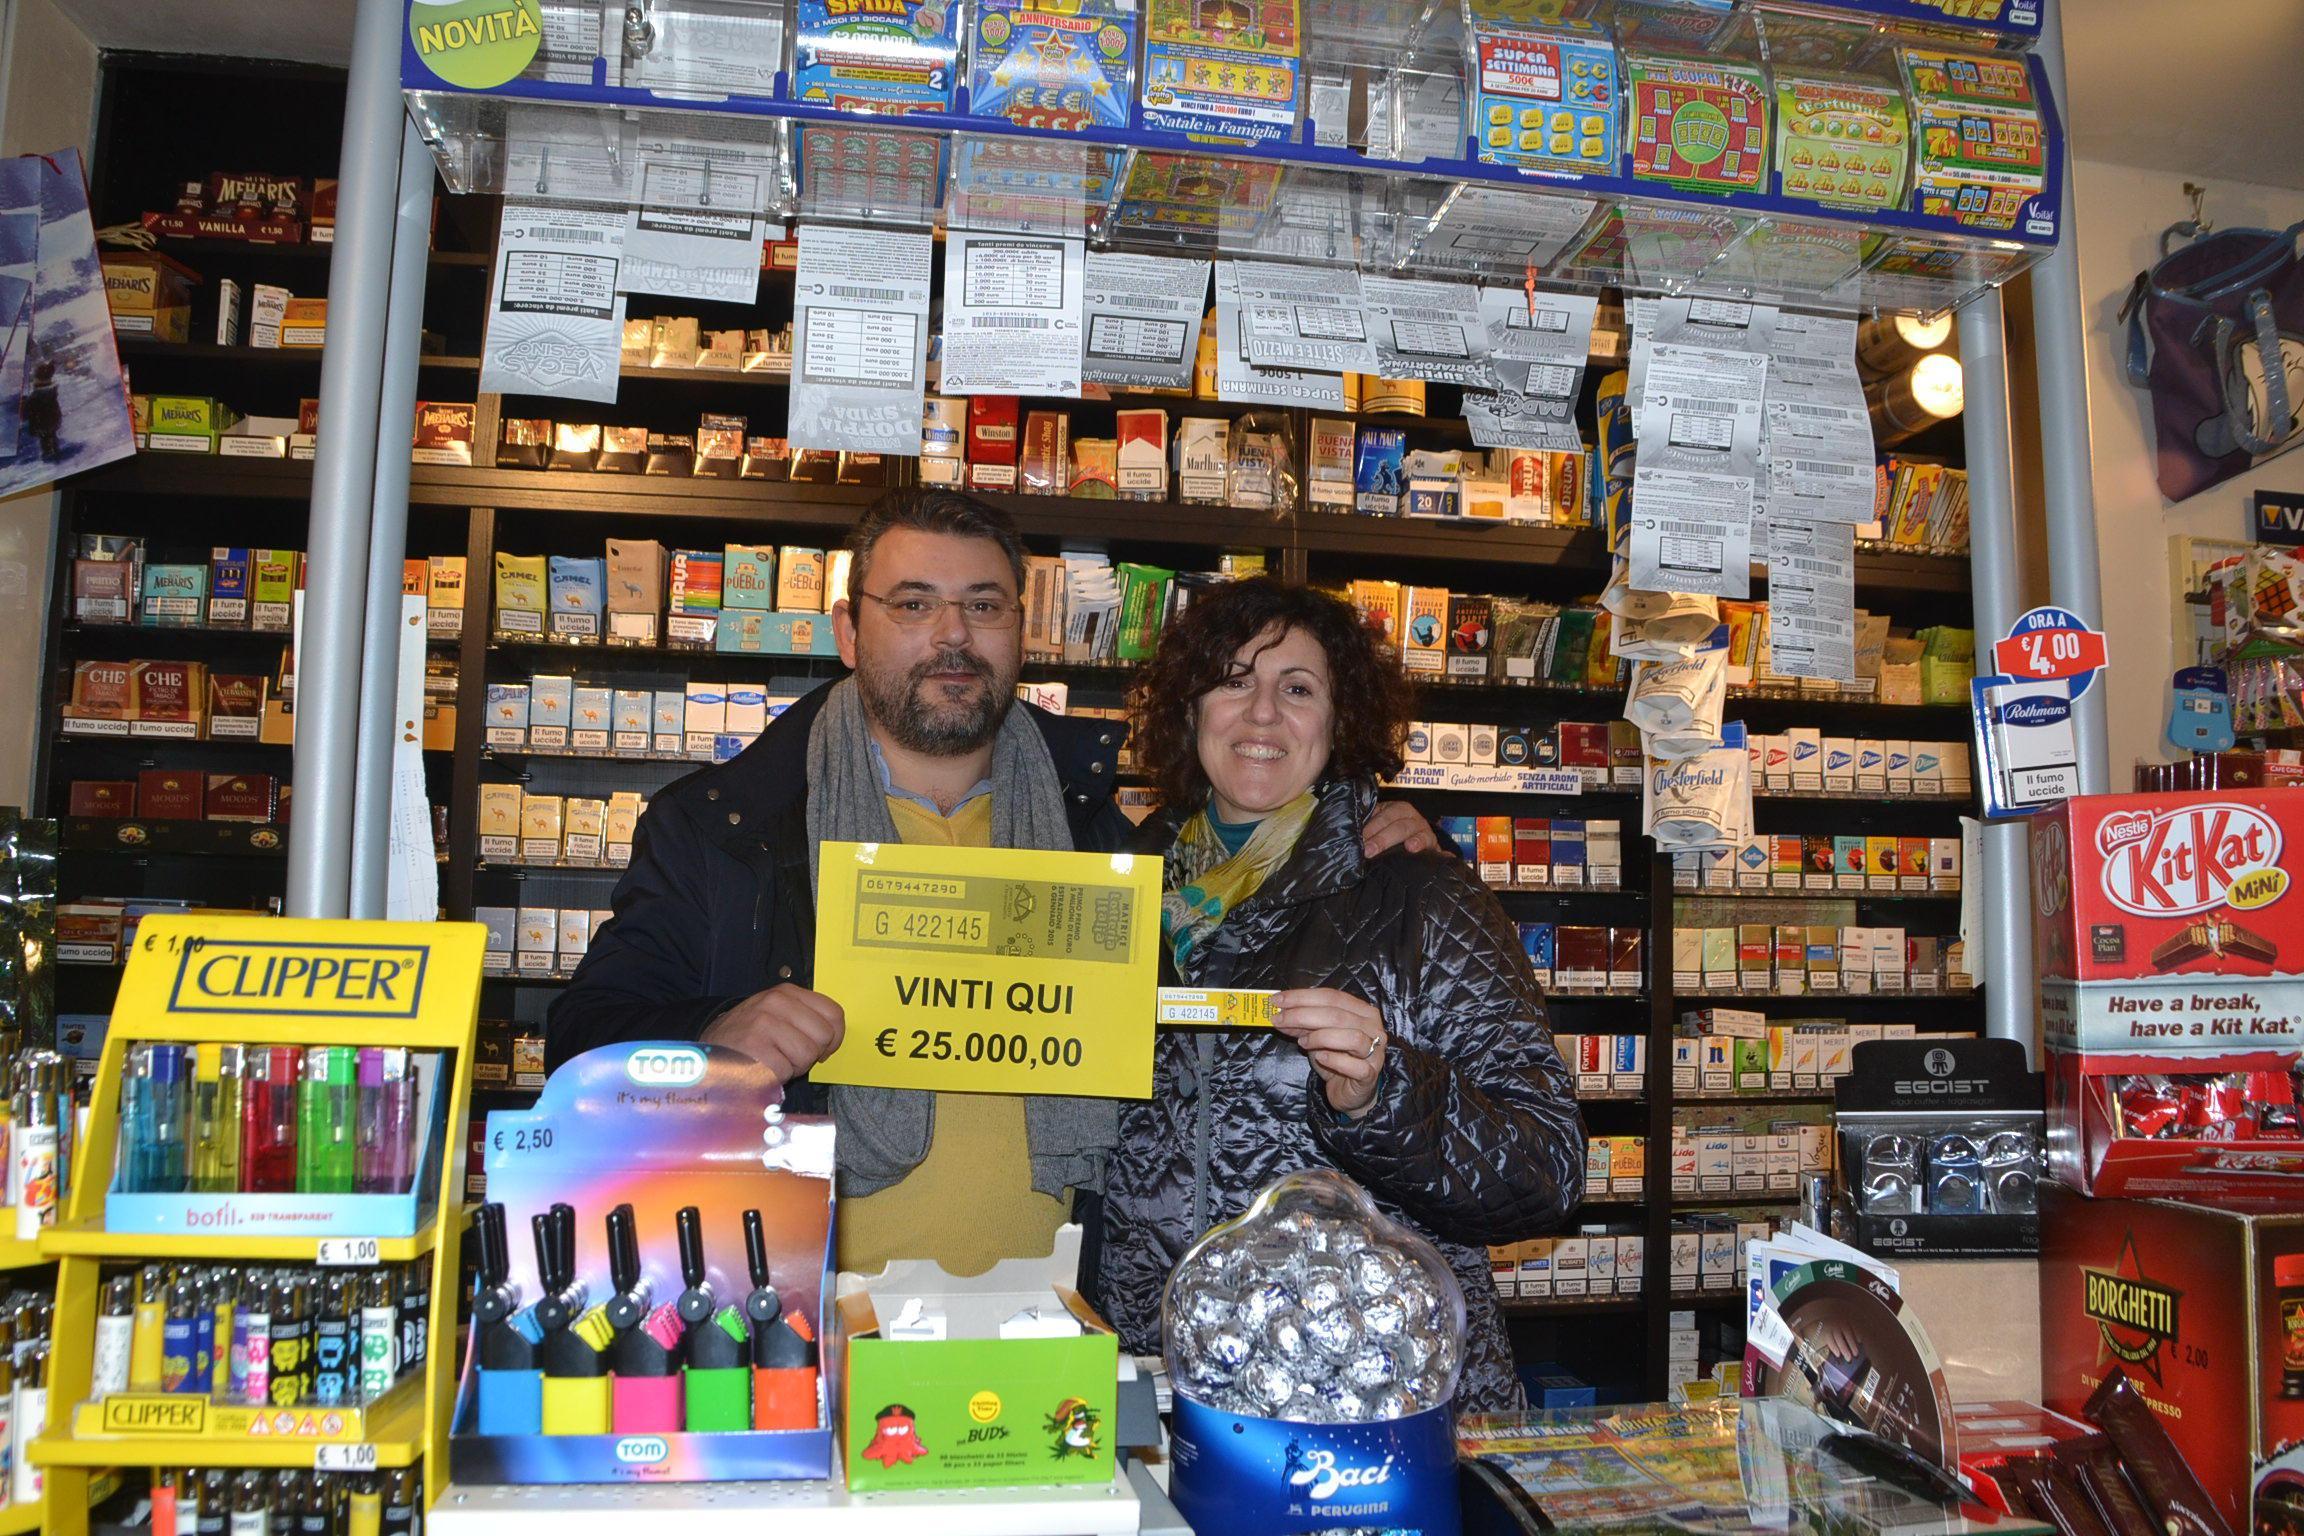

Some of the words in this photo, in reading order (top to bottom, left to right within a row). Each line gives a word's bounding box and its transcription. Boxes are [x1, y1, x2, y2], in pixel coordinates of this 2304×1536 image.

[418, 1, 540, 54] NOVITÀ
[820, 17, 849, 26] MODI
[850, 15, 864, 24] DI
[866, 15, 907, 26] GIOCARE!
[1018, 12, 1093, 32] ANNIVERSARIO
[1493, 47, 1548, 64] SUPER
[1486, 59, 1556, 77] SETTIMANA
[929, 70, 944, 89] 2
[1508, 74, 1536, 86] 500€
[1180, 101, 1196, 110] VINCI
[1196, 102, 1209, 111] FINO
[1214, 104, 1238, 114] 200.000
[1238, 106, 1252, 116] EURO
[1155, 113, 1202, 131] Natale
[1204, 121, 1216, 132] in
[1218, 123, 1282, 141] Famiglia
[2028, 201, 2054, 220] Voilà!
[168, 220, 184, 228] 1.50
[199, 222, 246, 234] VANILLA
[104, 277, 150, 294] MEHARI'S
[513, 301, 544, 312] vincere:
[545, 303, 556, 311] da
[556, 304, 579, 314] premi
[580, 306, 599, 316] Tanti
[516, 340, 590, 360] CASINO
[501, 354, 601, 383] VEGAS
[1258, 368, 1304, 381] 1.500€
[1381, 359, 1487, 378] PORTAFORTUNA
[1413, 369, 1465, 381] SUPER
[1131, 373, 1140, 384] in
[1140, 373, 1180, 387] Natale
[1221, 379, 1288, 397] SETTIMANA
[1291, 385, 1340, 401] SUPER
[832, 405, 900, 422] SFIDA
[1507, 395, 1569, 418] DADO
[160, 409, 203, 423] MEHARI'S
[422, 410, 468, 427] MEHARI'S
[819, 416, 917, 438] DOPPIA
[981, 427, 1012, 439] Winston
[925, 430, 957, 442] Winston
[1317, 435, 1353, 448] BUENA
[1319, 447, 1352, 458] VISTA
[1126, 478, 1152, 486] uccide
[1561, 459, 1574, 508] DRUM
[1417, 495, 1432, 508] 20
[86, 576, 120, 587] PRIMO
[153, 576, 194, 591] MEHARI'S
[500, 571, 540, 582] CAMEL
[553, 573, 593, 586] CAMEL
[725, 575, 767, 592] PUEBLO
[784, 573, 822, 592] PUEBLO
[558, 615, 564, 623] Il
[566, 616, 591, 625] fumo
[1410, 608, 1444, 617] SPIRIT
[1456, 614, 1488, 624] SPIRIT
[560, 624, 591, 632] uccide
[2028, 614, 2053, 630] ORA
[2057, 613, 2067, 627] A
[89, 669, 126, 685] CHE
[144, 671, 182, 687] CHE
[2005, 702, 2067, 721] Rothmans
[64, 721, 71, 729] Il
[72, 721, 95, 731] fumo
[97, 721, 128, 731] uccide
[131, 723, 138, 732] Il
[139, 723, 162, 732] fumo
[164, 723, 195, 734] uccide
[1451, 774, 1475, 786] Gusto
[1475, 772, 1512, 784] morbido
[1517, 772, 1546, 782] SENZA
[1548, 773, 1579, 784] AROMI
[1652, 769, 1723, 796] Chesterfield
[2026, 775, 2033, 785] Il
[2035, 773, 2065, 785] fumo
[1521, 781, 1574, 792] ARTIFICIALI
[2028, 785, 2065, 797] uccide
[2106, 818, 2149, 843] Nestlé
[866, 879, 958, 895] 0679447290
[1075, 887, 1084, 911] PRIMO
[1055, 886, 1065, 930] ESTRAZIONE
[1067, 893, 1076, 923] MILIONI
[875, 910, 889, 936] G
[903, 912, 982, 941] 422145
[1066, 924, 1074, 932] DI
[1074, 912, 1082, 941] PREMIO
[1119, 902, 1130, 948] MATRICE
[144, 935, 157, 951] €
[168, 936, 205, 955] 1,00
[1065, 934, 1074, 954] EURO
[2093, 937, 2120, 946] Cocoa
[2098, 943, 2117, 953] Plan
[197, 953, 398, 1001] CLIPPER
[894, 975, 994, 1011] VINTI
[1005, 982, 1074, 1016] QUI
[2108, 996, 2164, 1013] Have
[2170, 998, 2184, 1012] a
[2190, 993, 2261, 1013] break,
[1169, 1008, 1176, 1019] G
[1181, 1008, 1215, 1019] 422145
[2130, 1020, 2184, 1037] have
[2190, 1022, 2205, 1036] a
[2210, 1018, 2244, 1035] Kit
[2250, 1017, 2295, 1035] Kat.
[874, 1028, 898, 1057] €
[909, 1029, 1083, 1071] 25.000,00
[1795, 1037, 1817, 1047] MERIT
[1823, 1038, 1846, 1047] MERIT
[1894, 1080, 1990, 1095] EGOIST
[616, 1091, 637, 1105] it's
[639, 1094, 661, 1108] my
[666, 1091, 708, 1105] flame!
[494, 1131, 504, 1150] €
[515, 1128, 554, 1153] 2,50
[1705, 1142, 1728, 1151] Lido
[1804, 1130, 1828, 1168] Vogue
[1613, 1158, 1643, 1170] PUEBLO
[1873, 1237, 1926, 1248] EGOIST
[320, 1243, 330, 1260] €
[344, 1240, 377, 1262] 1,00
[2088, 1275, 2172, 1335] BORGHETTI
[112, 1402, 198, 1427] CLIPPER
[967, 1426, 1009, 1444] BUDS
[318, 1449, 329, 1466] €
[343, 1445, 376, 1467] 1,00
[1289, 1449, 1395, 1500] Baci
[1310, 1501, 1389, 1518] PERUGINA
